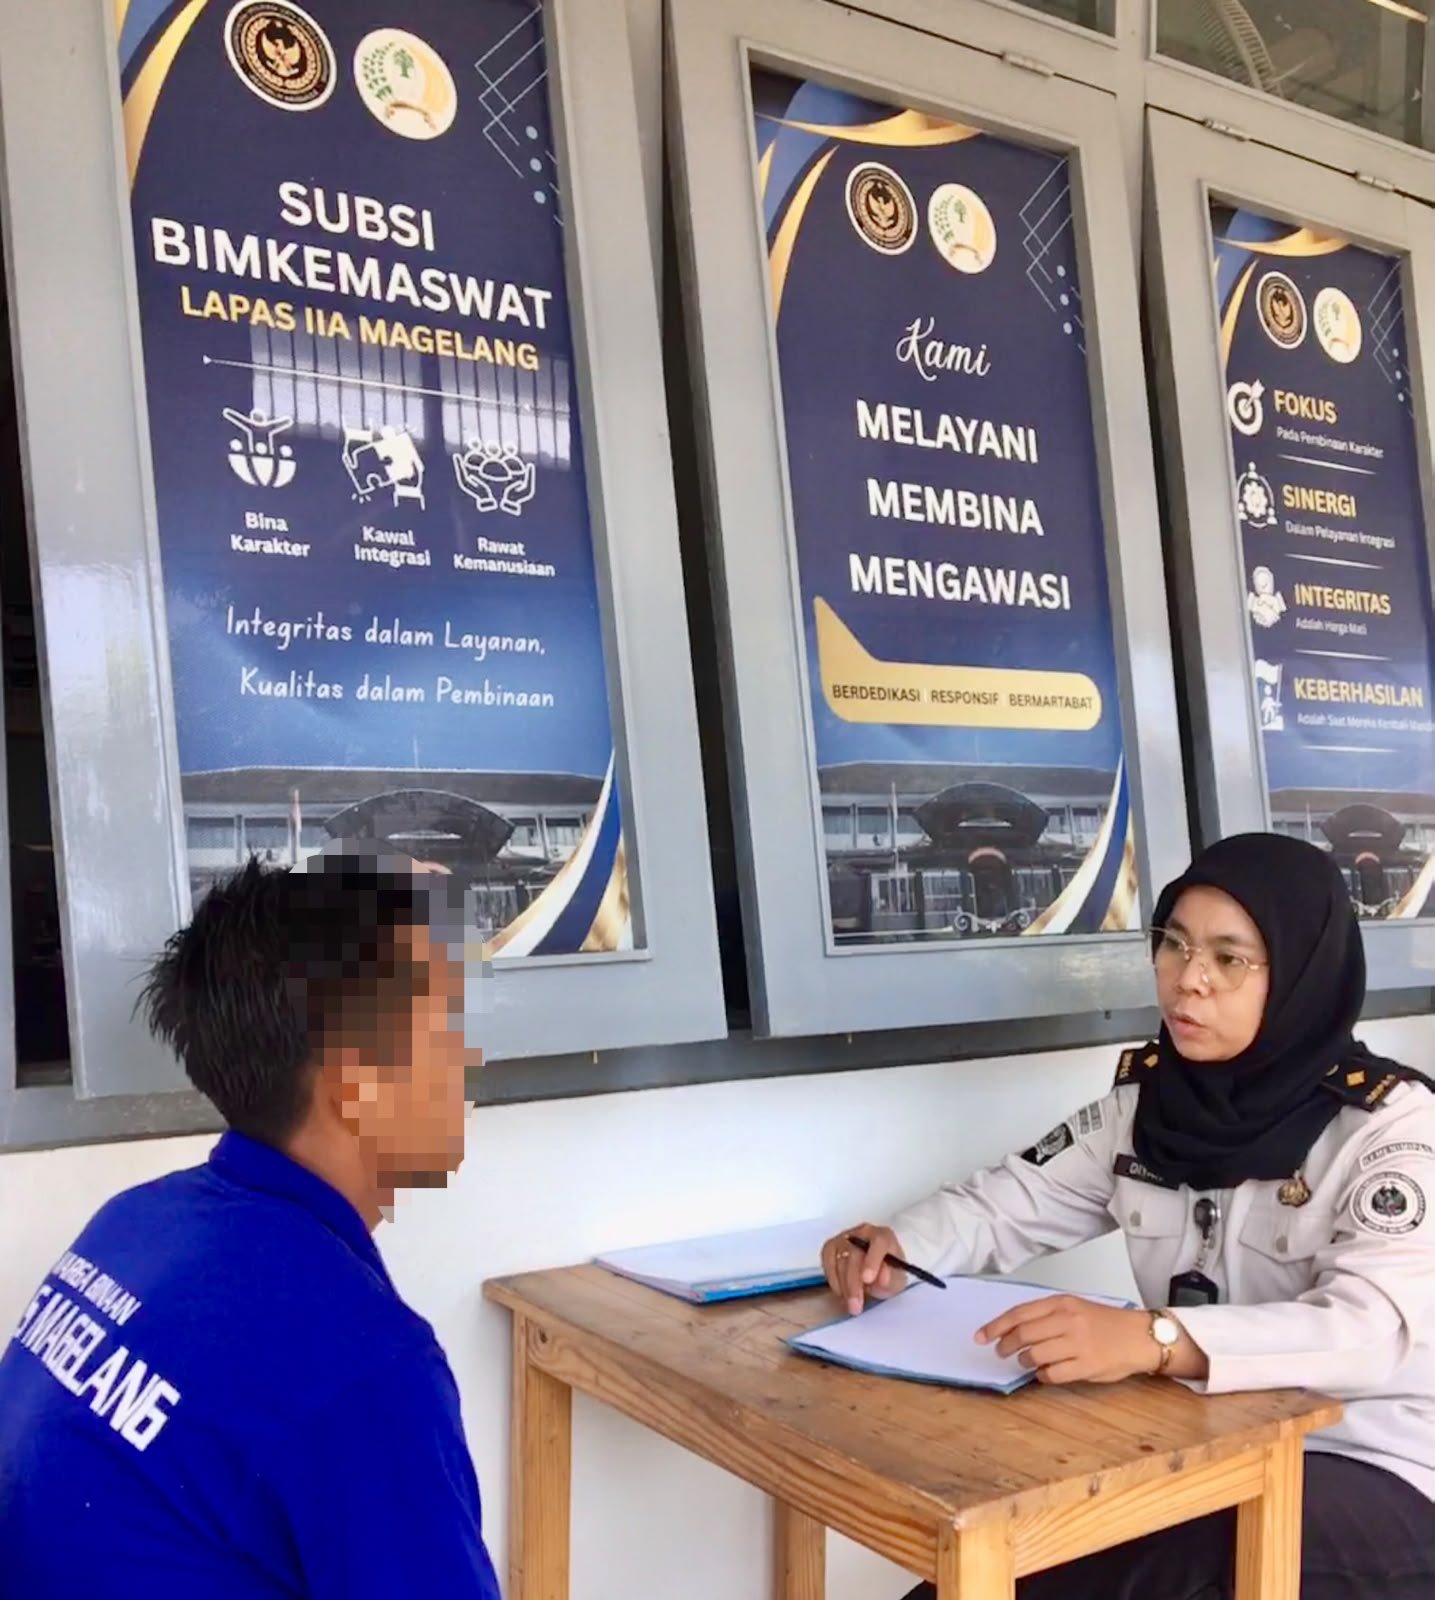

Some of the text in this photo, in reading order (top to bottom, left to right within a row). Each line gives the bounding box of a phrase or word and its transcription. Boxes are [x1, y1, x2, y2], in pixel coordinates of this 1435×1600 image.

[278, 181, 435, 251] SUBSI
[151, 217, 552, 329] BIMKEMASWAT
[181, 286, 539, 370] LAPAS IIA MAGELANG
[895, 317, 992, 381] Kami
[1273, 389, 1338, 424] FOKUS
[856, 399, 1039, 464] MELAYANI
[867, 478, 1044, 536] MEMBINA
[1282, 484, 1357, 518] SINERGI
[245, 512, 288, 533] Bina
[363, 526, 415, 547] Kawal
[230, 535, 311, 558] Karakter
[354, 544, 431, 568] Integrasi
[477, 537, 525, 556] Rawat
[454, 554, 555, 577] Kemanusiaan
[849, 553, 1071, 610] MENGAWASI
[1293, 584, 1392, 615] INTEGRITAS
[226, 605, 353, 651] Integritas
[365, 617, 434, 647] dalam
[240, 667, 555, 707] Kualitas dalam Pembinaan
[832, 685, 1092, 709] BERDEDIKASI RESPONSIF BERMARTABAT
[1293, 677, 1424, 707] KEBERHASILAN
[21, 1292, 181, 1451] MAGELANG
